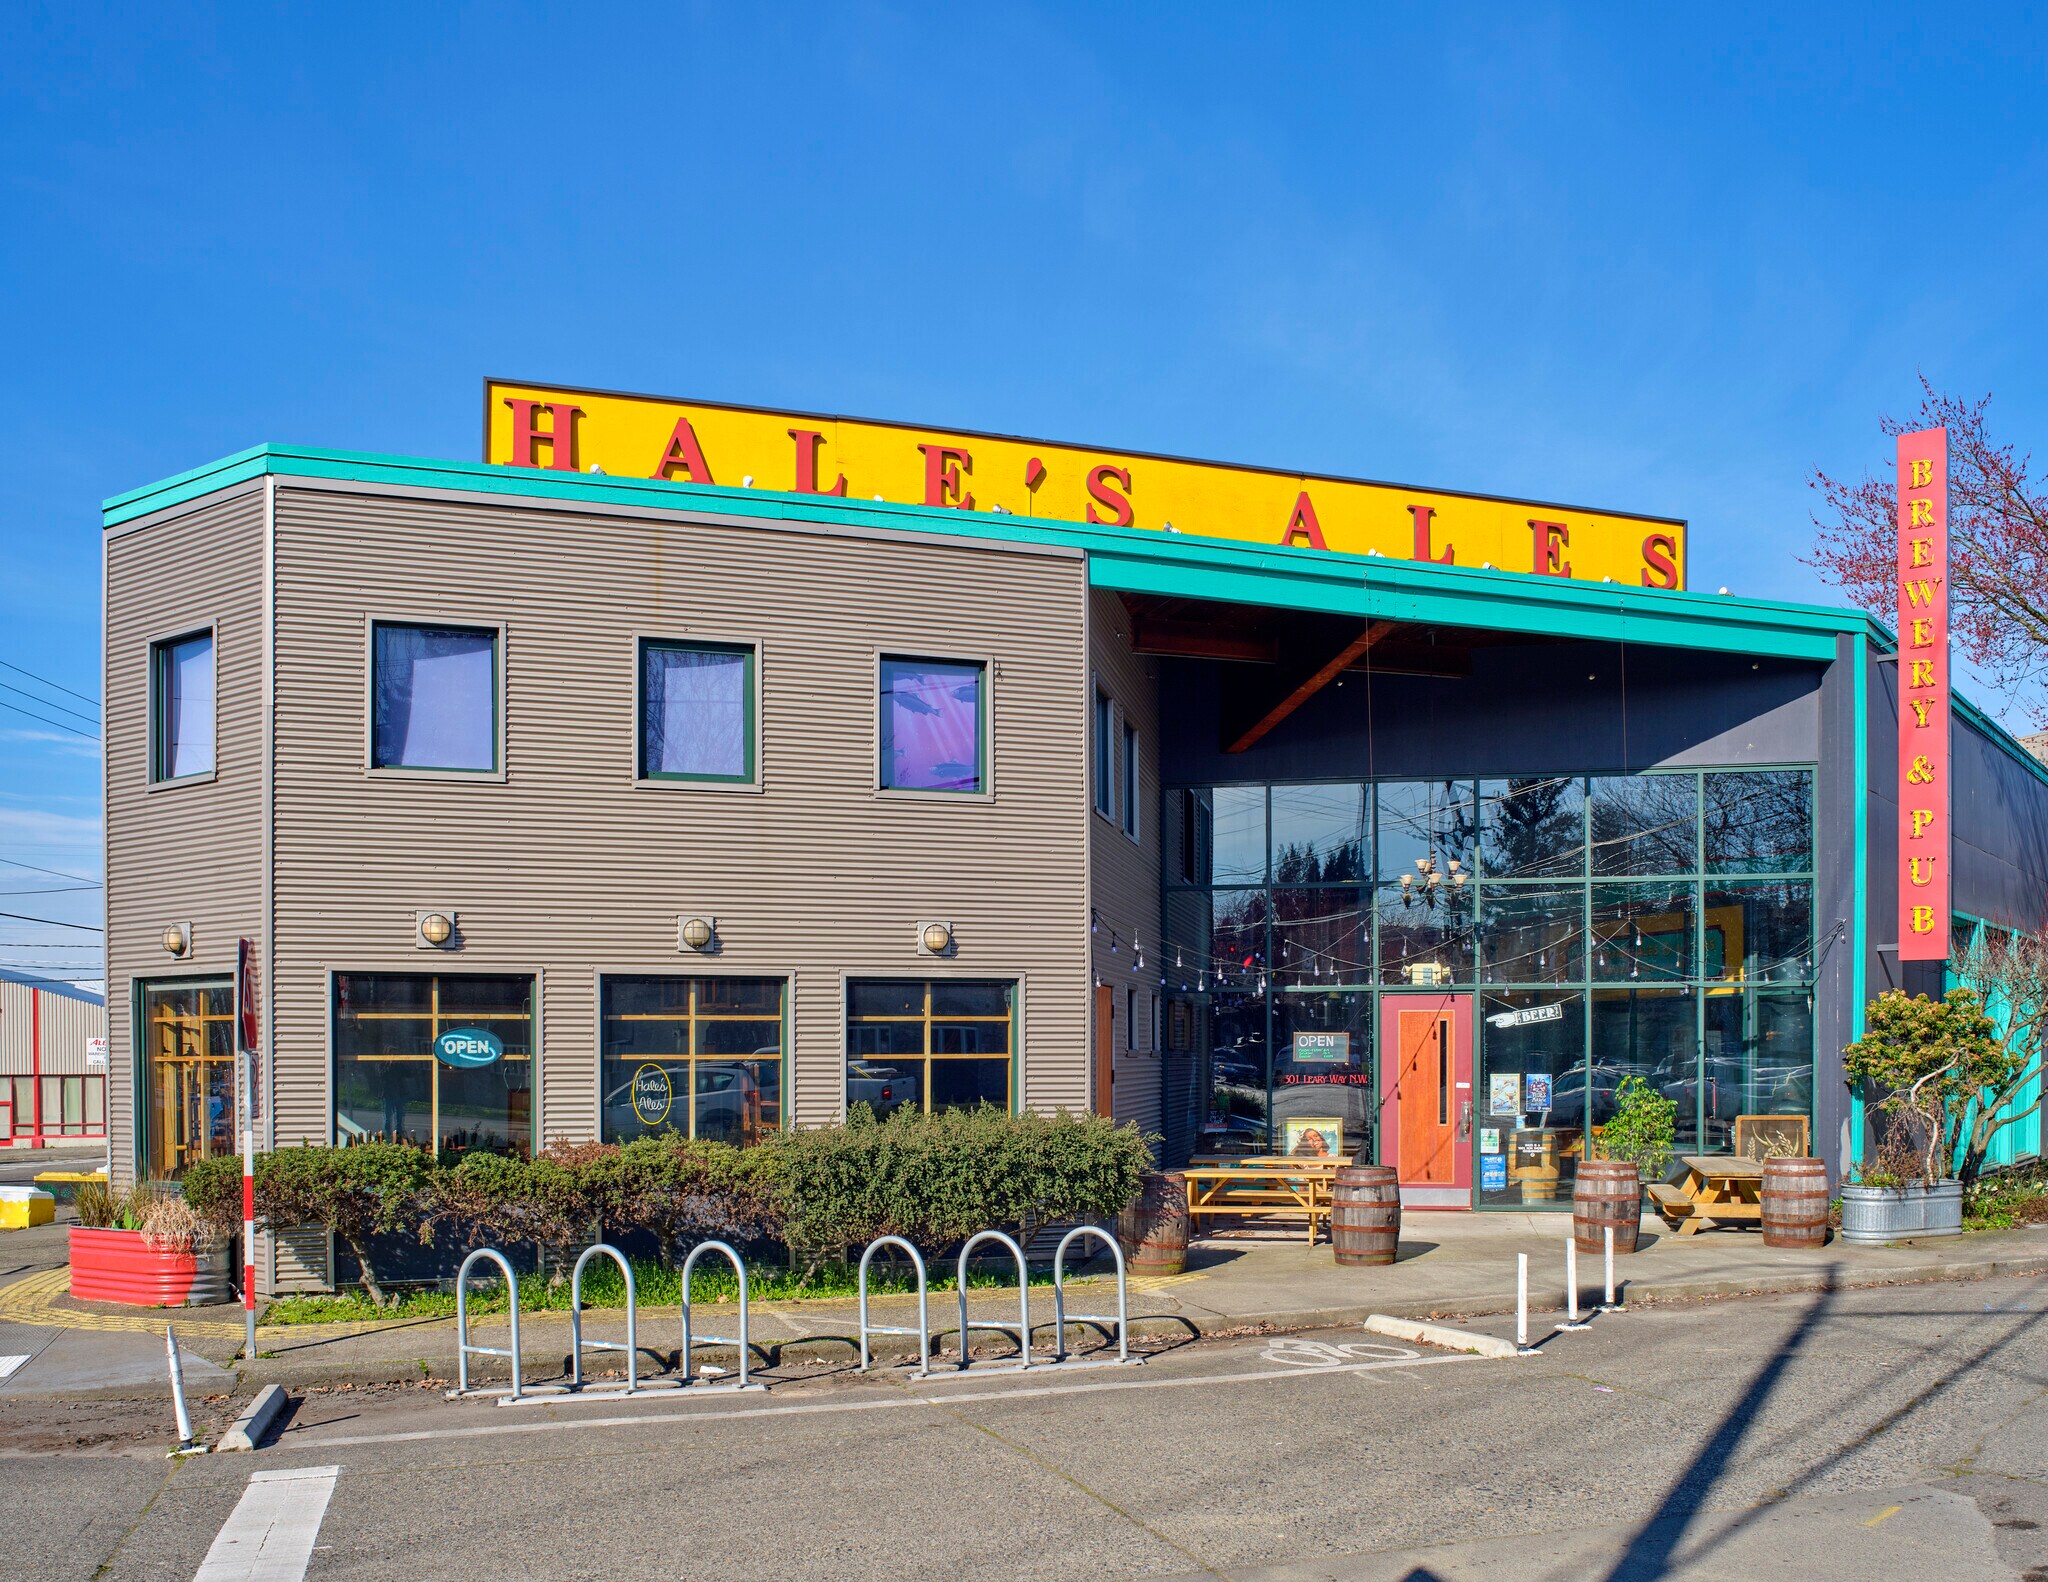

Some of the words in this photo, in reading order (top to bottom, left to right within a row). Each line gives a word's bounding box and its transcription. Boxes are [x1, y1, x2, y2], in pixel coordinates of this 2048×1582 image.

[503, 397, 1131, 528] HALE'S
[1279, 491, 1677, 590] ALES
[1903, 459, 1942, 728] BREWERY
[1906, 754, 1936, 786] &
[1908, 808, 1937, 936] PUB
[1522, 1006, 1559, 1022] BEER!
[444, 1040, 490, 1055] OPEN
[1298, 1035, 1334, 1047] OPEN
[635, 1077, 668, 1092] Hale's
